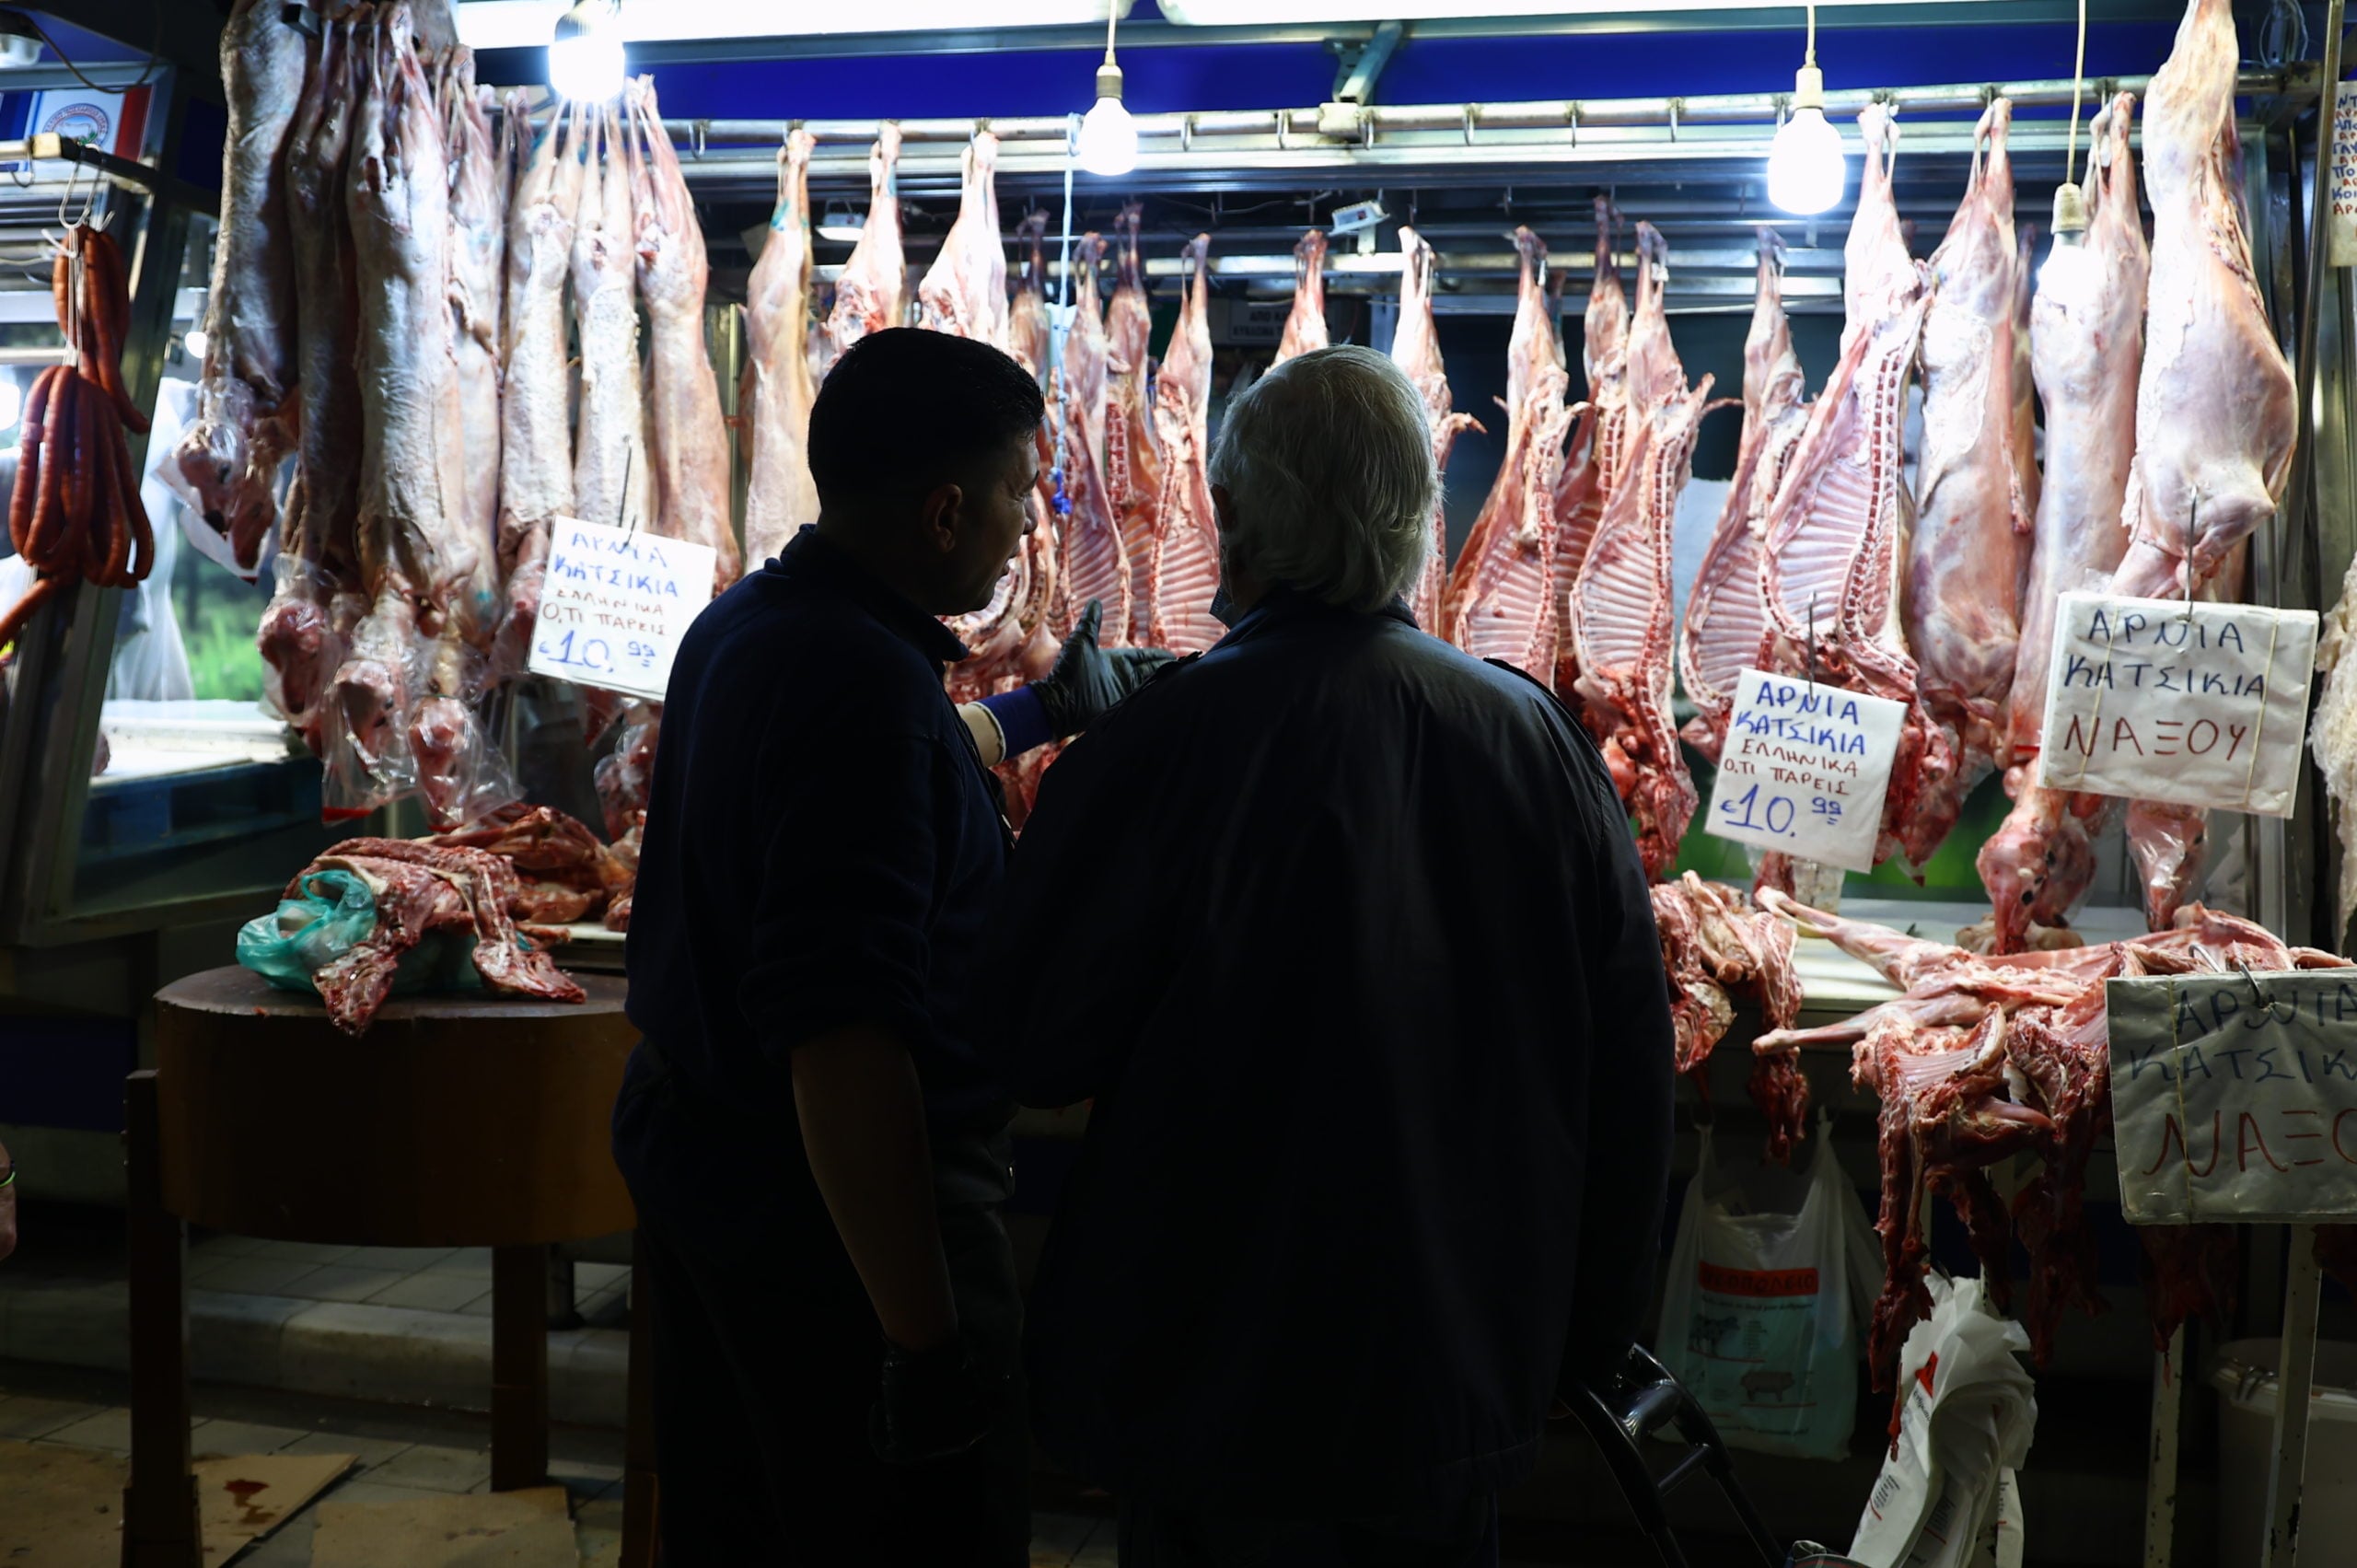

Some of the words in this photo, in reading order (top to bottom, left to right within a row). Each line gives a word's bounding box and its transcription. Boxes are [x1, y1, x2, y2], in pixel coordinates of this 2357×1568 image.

[554, 554, 678, 597] ΚΑΤΣΙΚΙΑ
[2088, 609, 2244, 654] ΑΡΝΙΑ
[2064, 655, 2266, 703] ΚΑΤΣΙΚΙΑ
[1756, 681, 1859, 725] ΑΡΝΙΑ
[1736, 710, 1865, 755] ΚΑΤΣΙΚΙΑ
[2064, 714, 2247, 761] ΝΑΞΟΥ
[1741, 738, 1858, 777] ΕΛΛΗΝΙΚΑ
[1770, 766, 1850, 796] ΠΑΡΕΙΣ
